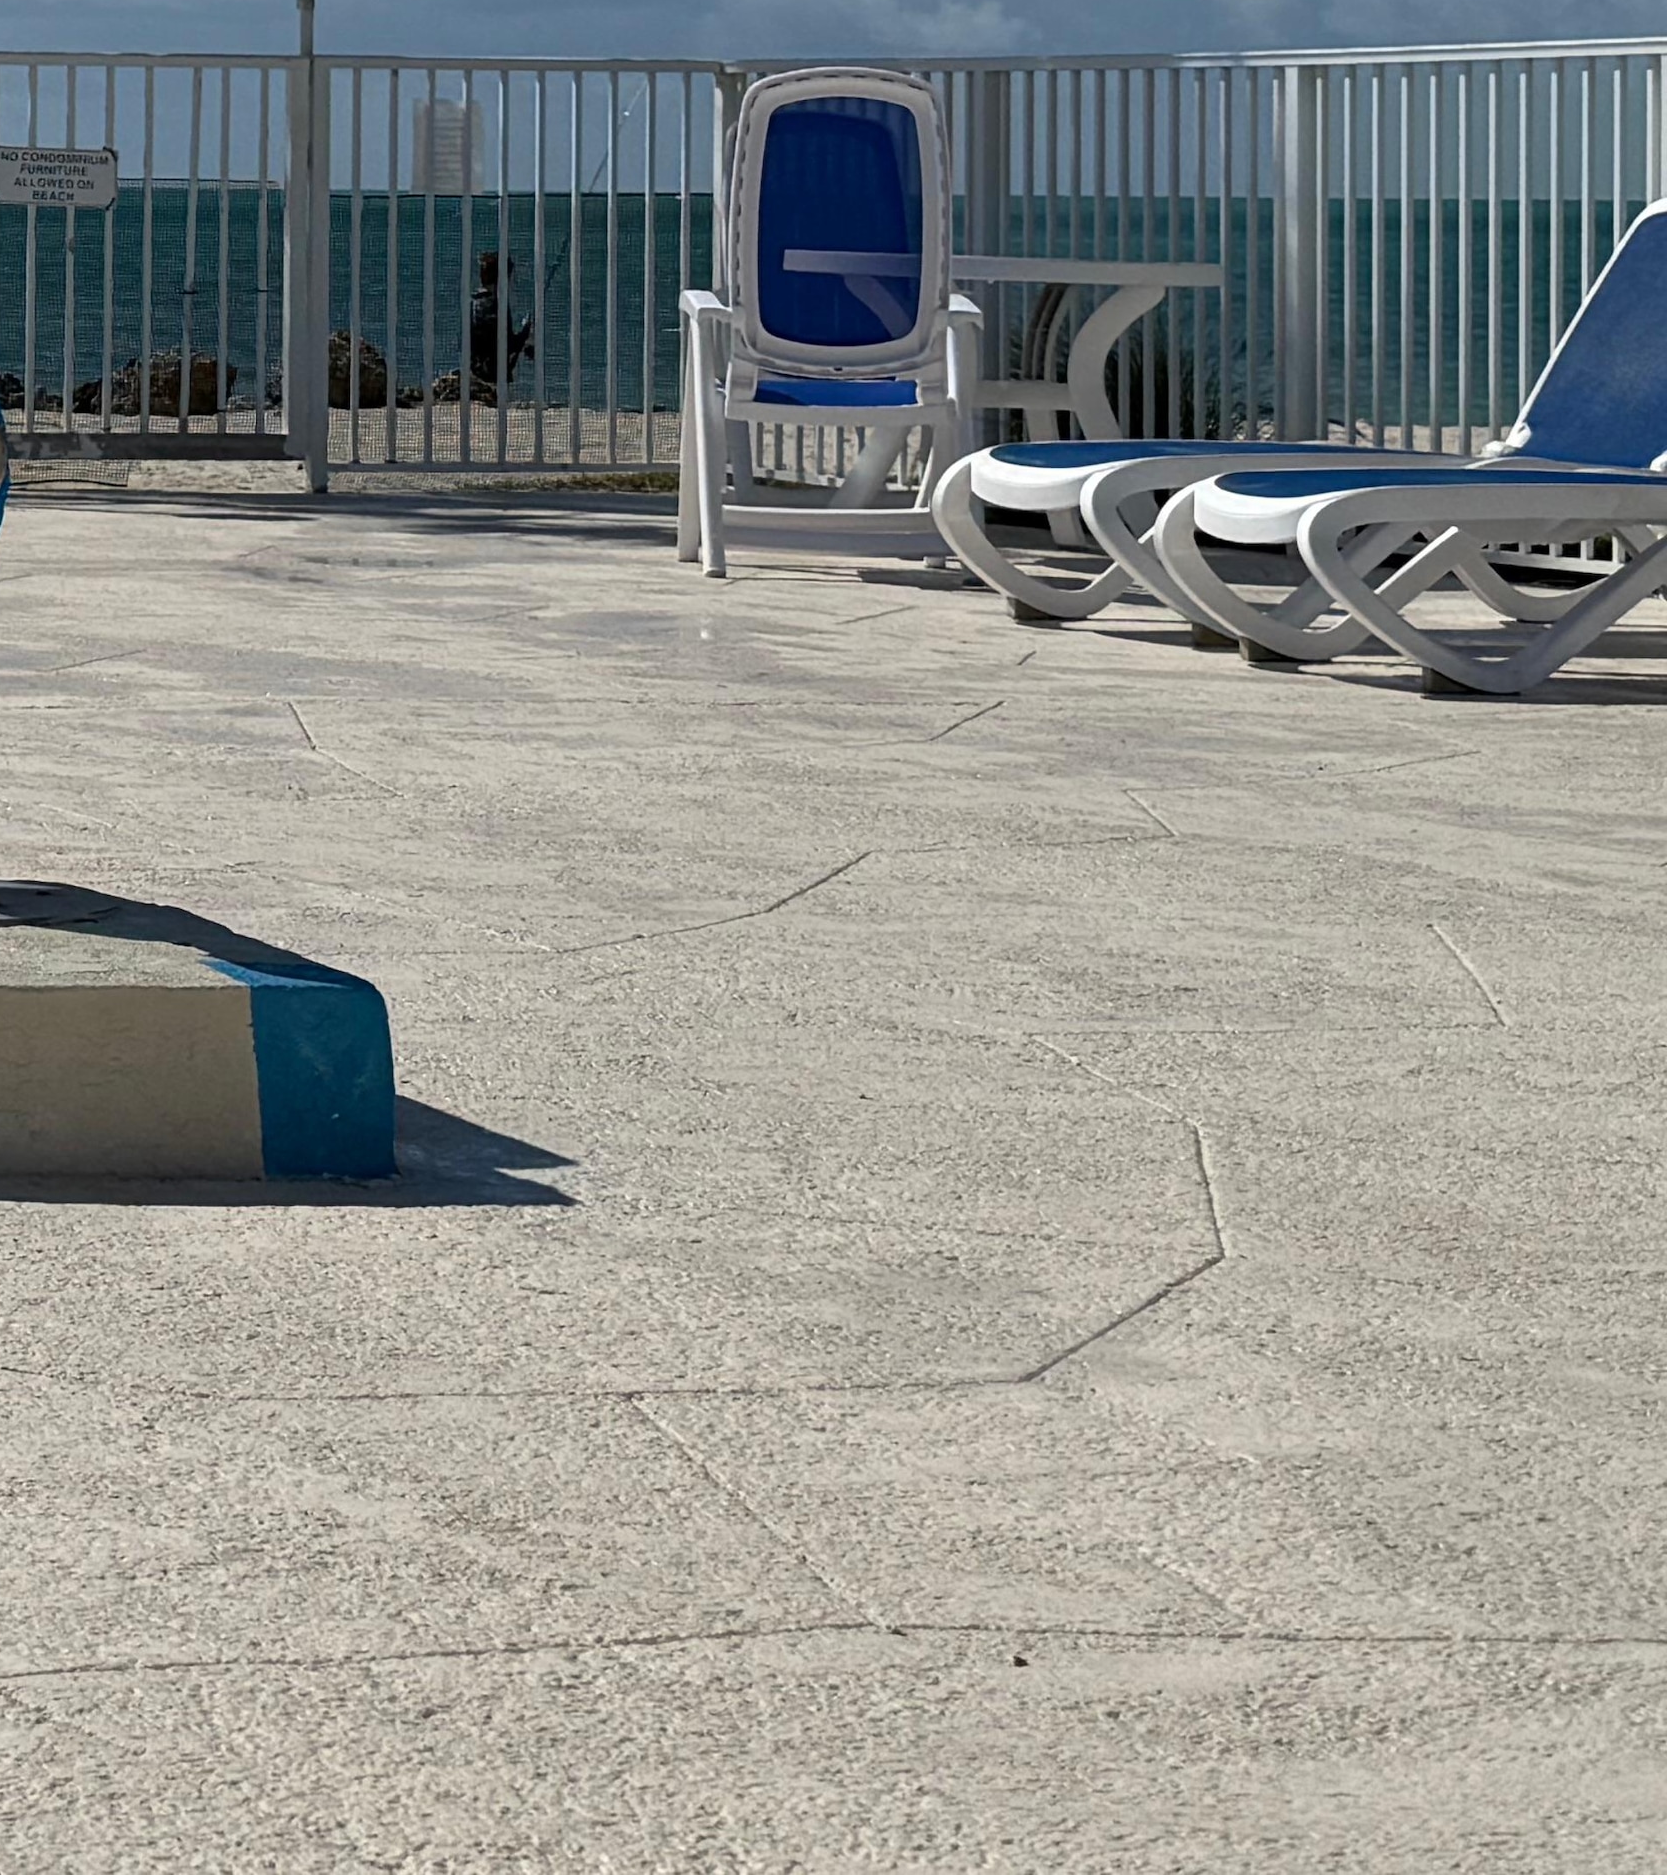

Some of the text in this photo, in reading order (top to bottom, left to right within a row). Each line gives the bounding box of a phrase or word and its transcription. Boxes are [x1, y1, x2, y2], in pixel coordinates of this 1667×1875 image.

[0, 151, 18, 161] NO
[19, 164, 88, 176] FURNITURE
[14, 177, 95, 190] ALLOWED ON
[32, 190, 74, 201] BEACH
